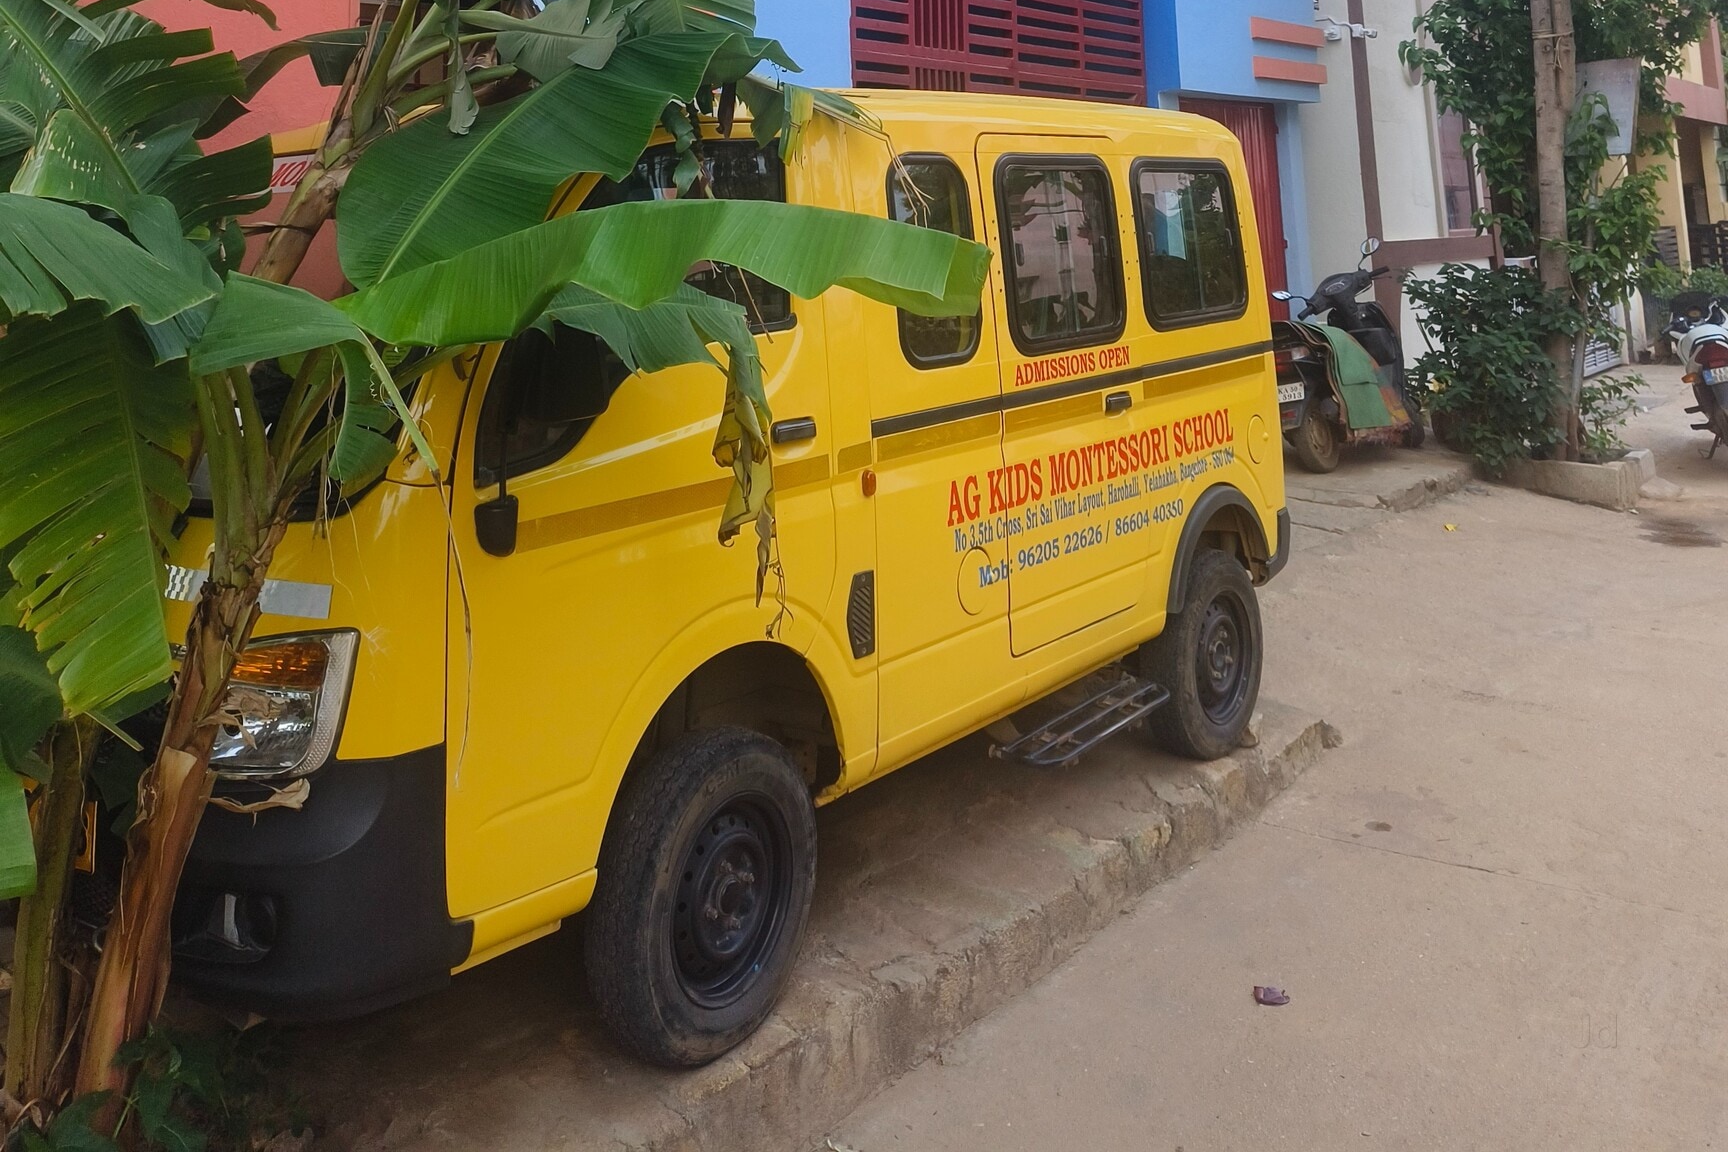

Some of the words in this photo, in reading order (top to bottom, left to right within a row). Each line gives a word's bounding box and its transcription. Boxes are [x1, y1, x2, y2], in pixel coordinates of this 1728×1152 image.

[1015, 353, 1096, 386] ADMISSIONS
[1100, 346, 1130, 370] OPEN
[947, 475, 981, 527] AG
[988, 458, 1043, 514] KIDS
[1048, 425, 1170, 496] MONTESSORI
[1173, 408, 1233, 458] SCHOOL
[955, 528, 967, 552] No
[996, 516, 1024, 540] Cross,
[1026, 505, 1038, 530] Sri
[1040, 499, 1053, 525] Sai
[1054, 495, 1075, 521] Vihar
[1078, 491, 1106, 517] Layout,
[1018, 538, 1060, 570] 96205
[1064, 524, 1103, 554] 22626
[1105, 519, 1110, 544] /
[1115, 509, 1150, 536] 86604
[1152, 498, 1184, 524] 40350
